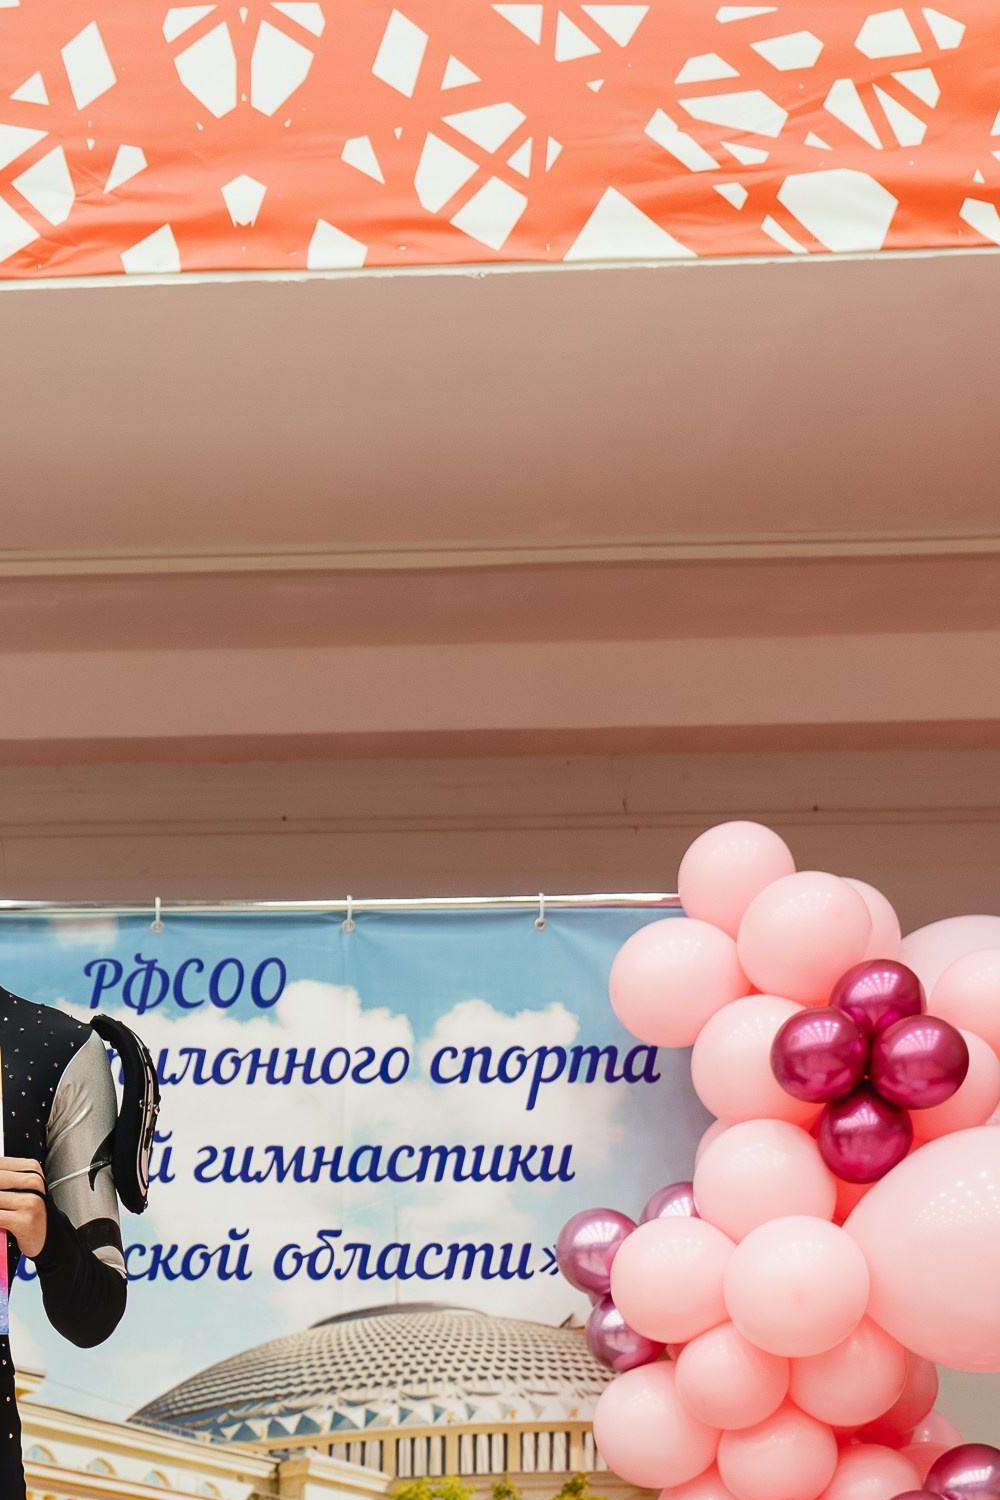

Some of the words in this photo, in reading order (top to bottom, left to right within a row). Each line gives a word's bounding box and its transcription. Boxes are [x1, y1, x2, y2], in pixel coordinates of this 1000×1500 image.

[83, 952, 287, 1015] РФСОО
[430, 1044, 661, 1111] спорта
[194, 1140, 575, 1183] гимнастики
